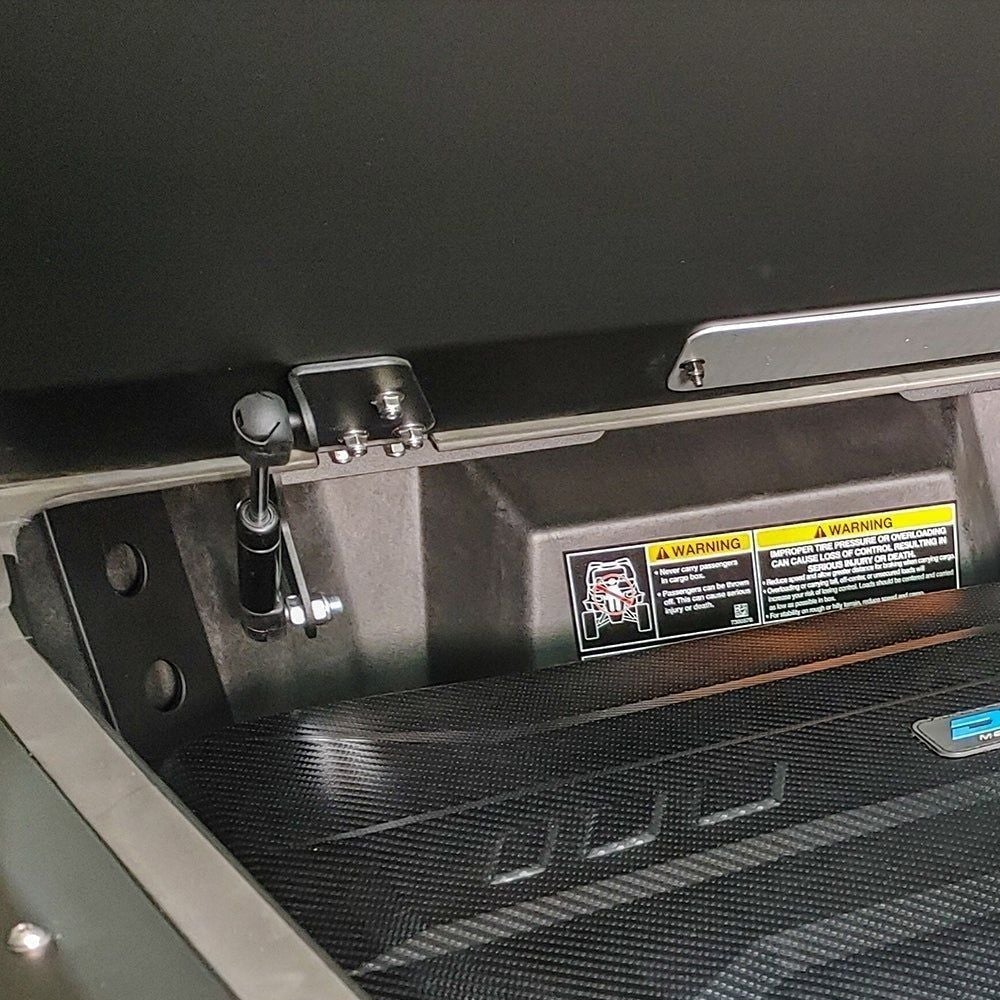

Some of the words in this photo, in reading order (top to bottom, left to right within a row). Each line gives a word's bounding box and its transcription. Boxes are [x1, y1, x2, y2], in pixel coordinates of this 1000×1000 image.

[829, 518, 892, 535] WARNING
[672, 538, 740, 557] WARNING
[770, 545, 814, 558] IMPROPER
[814, 542, 833, 552] TIRE
[834, 536, 876, 549] PRESSURE
[891, 527, 946, 541] OVERLOADING
[771, 559, 790, 568] CAN
[790, 554, 818, 565] CAUSE
[820, 552, 840, 561] LOSS
[842, 550, 854, 558] OF
[854, 545, 893, 556] CONTROL
[894, 538, 938, 551] RESULTING
[938, 536, 947, 544] IN
[681, 565, 698, 573] carry
[700, 560, 738, 570] passengers
[808, 560, 843, 572] SERIOUS
[844, 556, 873, 568] INJURY
[874, 554, 887, 563] OR
[888, 550, 916, 562] DEATH.
[669, 575, 688, 584] cargo
[662, 587, 702, 597] Passengers
[726, 580, 750, 588] thrown
[706, 592, 726, 600] cause
[727, 588, 751, 597] serious
